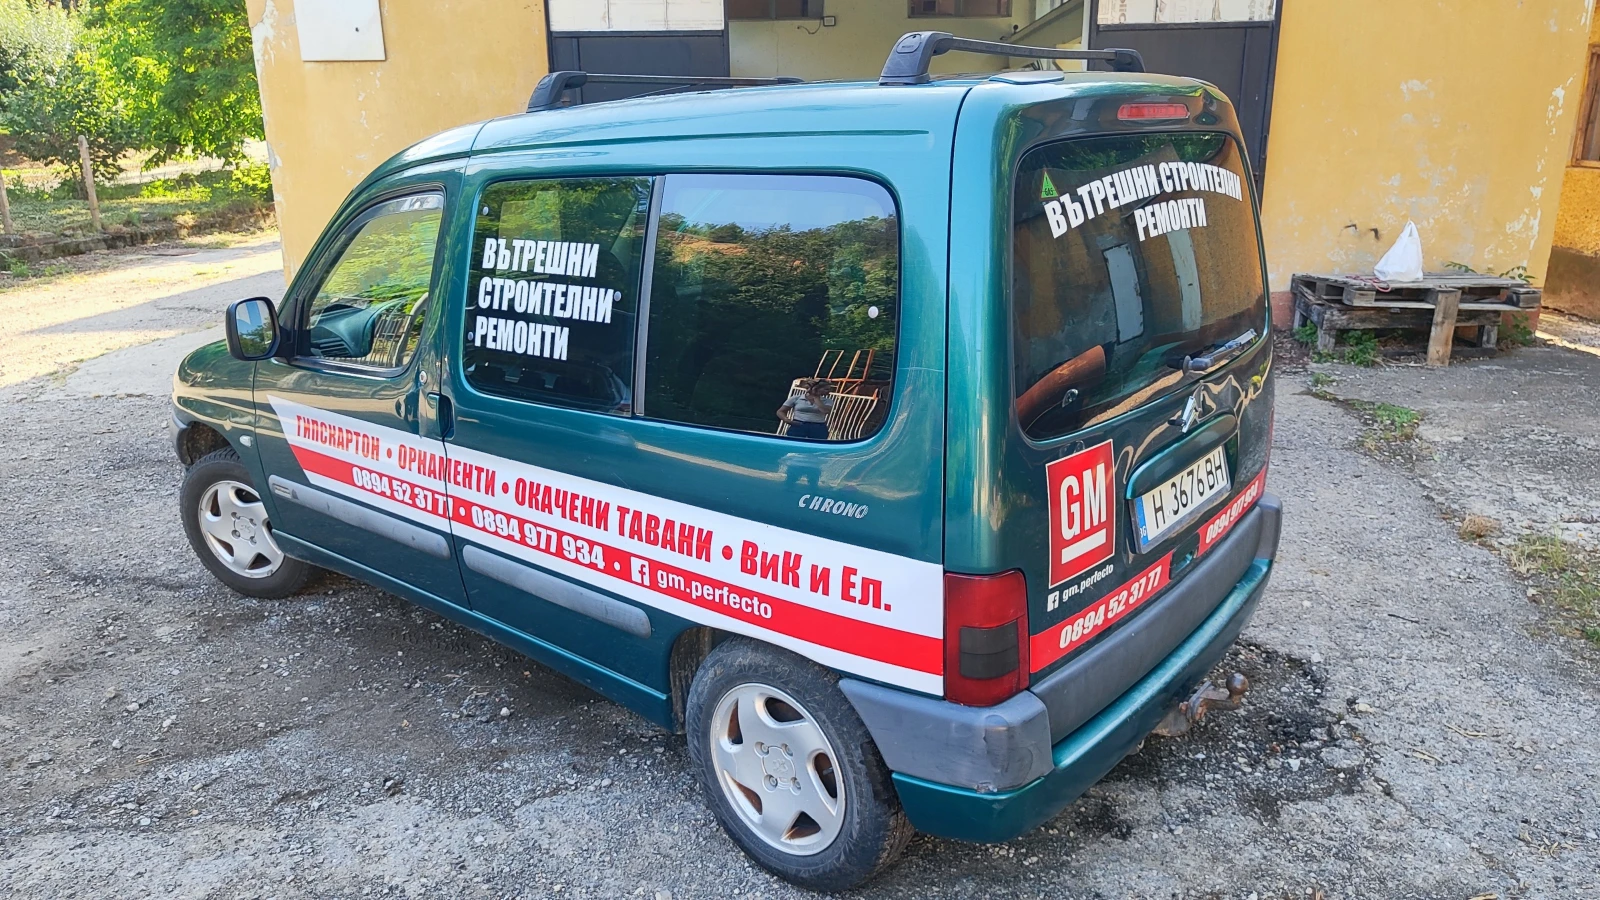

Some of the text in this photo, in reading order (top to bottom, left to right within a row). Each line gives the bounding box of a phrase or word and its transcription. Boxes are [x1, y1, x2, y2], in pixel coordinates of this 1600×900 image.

[1043, 161, 1243, 239] ВЪТРЕШНИ СТРОИТЕЛНИ
[1133, 197, 1207, 242] РЕМОНТИ
[481, 237, 600, 278] ВЪТРЕШНИ
[478, 276, 615, 324] СТРОИТЕЛНИ
[474, 315, 570, 361] РЕМОНТИ
[296, 414, 892, 612] ГИПСКАРТОН ОРНАМЕНТИ ОКАЧЕНИ ТАВАНИ ВиК и Ел.
[798, 493, 869, 520] CHRONO
[1059, 462, 1107, 541] GM
[1170, 464, 1205, 516] 3676
[352, 466, 392, 497] 0894
[392, 479, 413, 505] 52
[414, 487, 432, 511] 37
[471, 505, 521, 541] 0894
[523, 521, 558, 556] 977
[563, 536, 606, 571] 934
[656, 566, 773, 620] gm.perfecto
[1059, 565, 1162, 649] 0894 52 37 77
[1062, 564, 1114, 602] gm.perfecto
